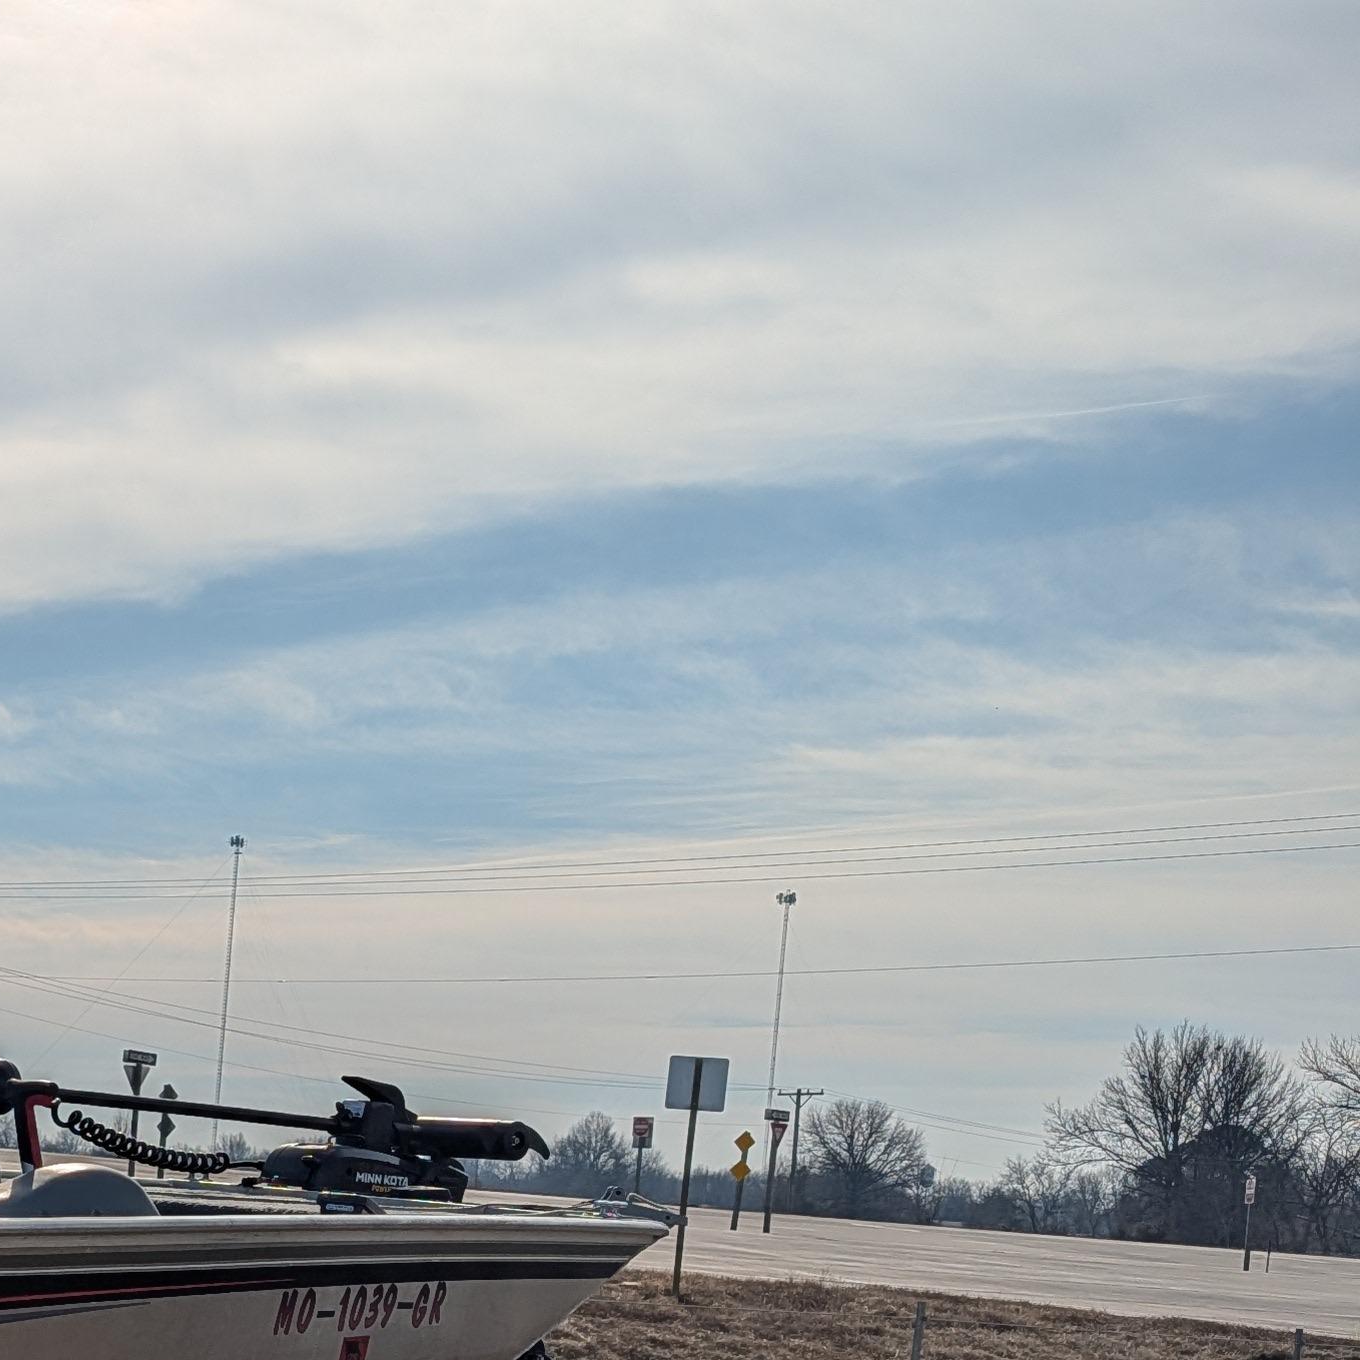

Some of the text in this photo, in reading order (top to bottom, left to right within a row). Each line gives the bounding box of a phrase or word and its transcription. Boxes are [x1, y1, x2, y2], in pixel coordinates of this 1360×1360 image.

[355, 1171, 409, 1187] MINN KOTA
[273, 1281, 447, 1335] MO-1039-GR
